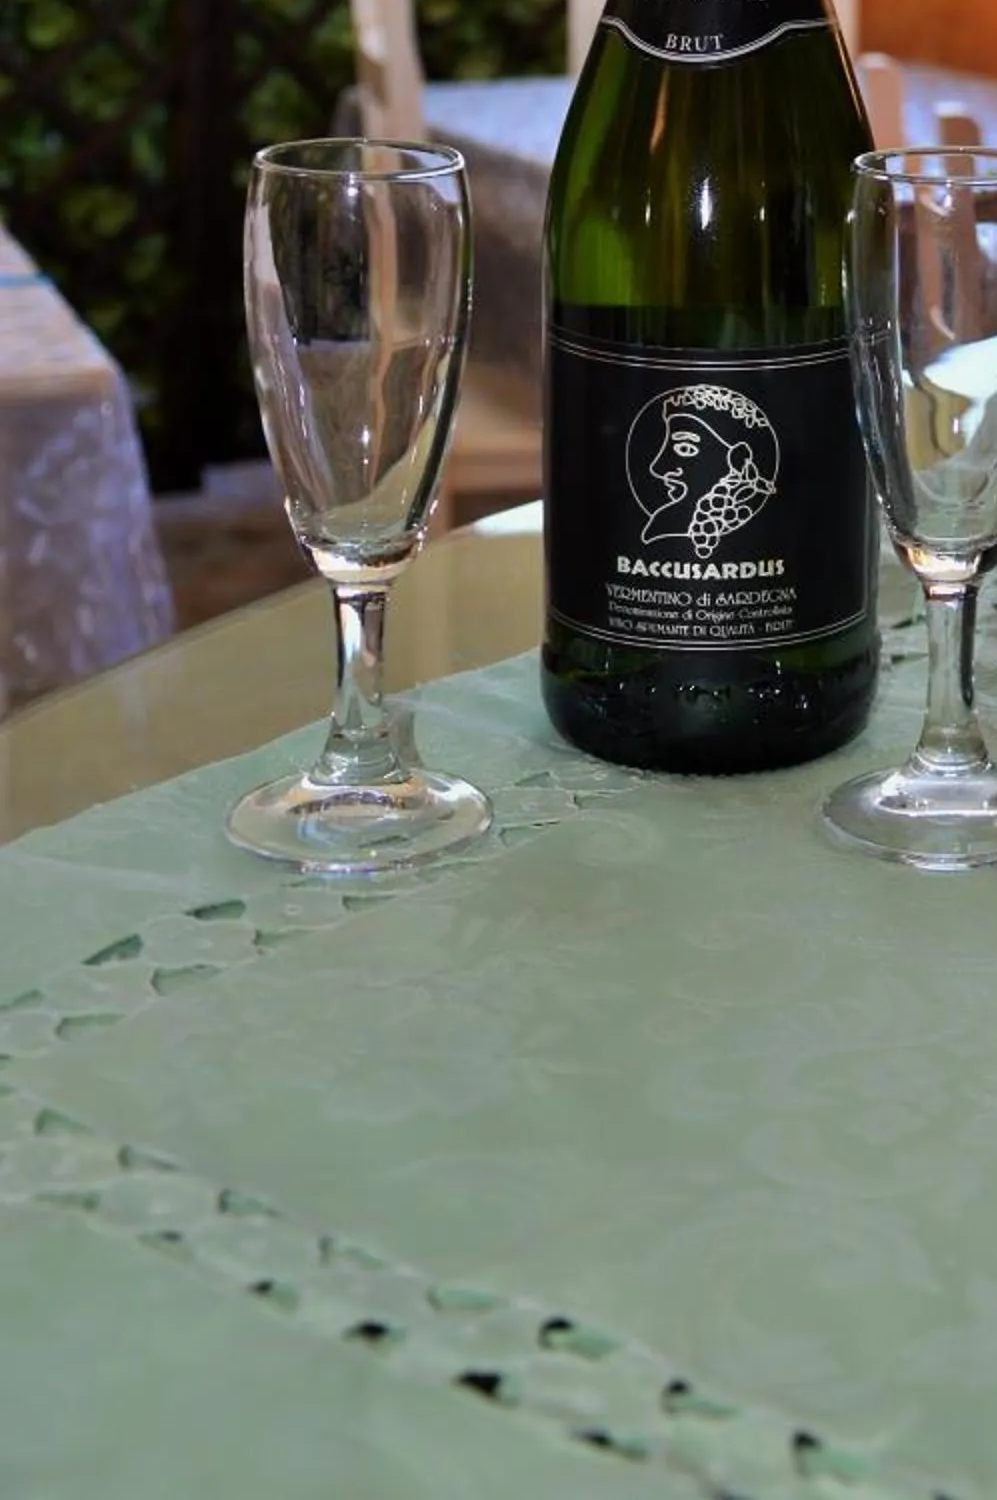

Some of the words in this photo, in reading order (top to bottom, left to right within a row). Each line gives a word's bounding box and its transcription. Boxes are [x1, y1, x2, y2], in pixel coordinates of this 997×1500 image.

[665, 33, 724, 52] BRUT
[617, 556, 785, 580] BACCUSARDUS
[605, 583, 693, 606] VERMENTINO
[696, 593, 711, 607] di
[715, 587, 798, 607] SARDEGNA
[681, 608, 693, 621] di
